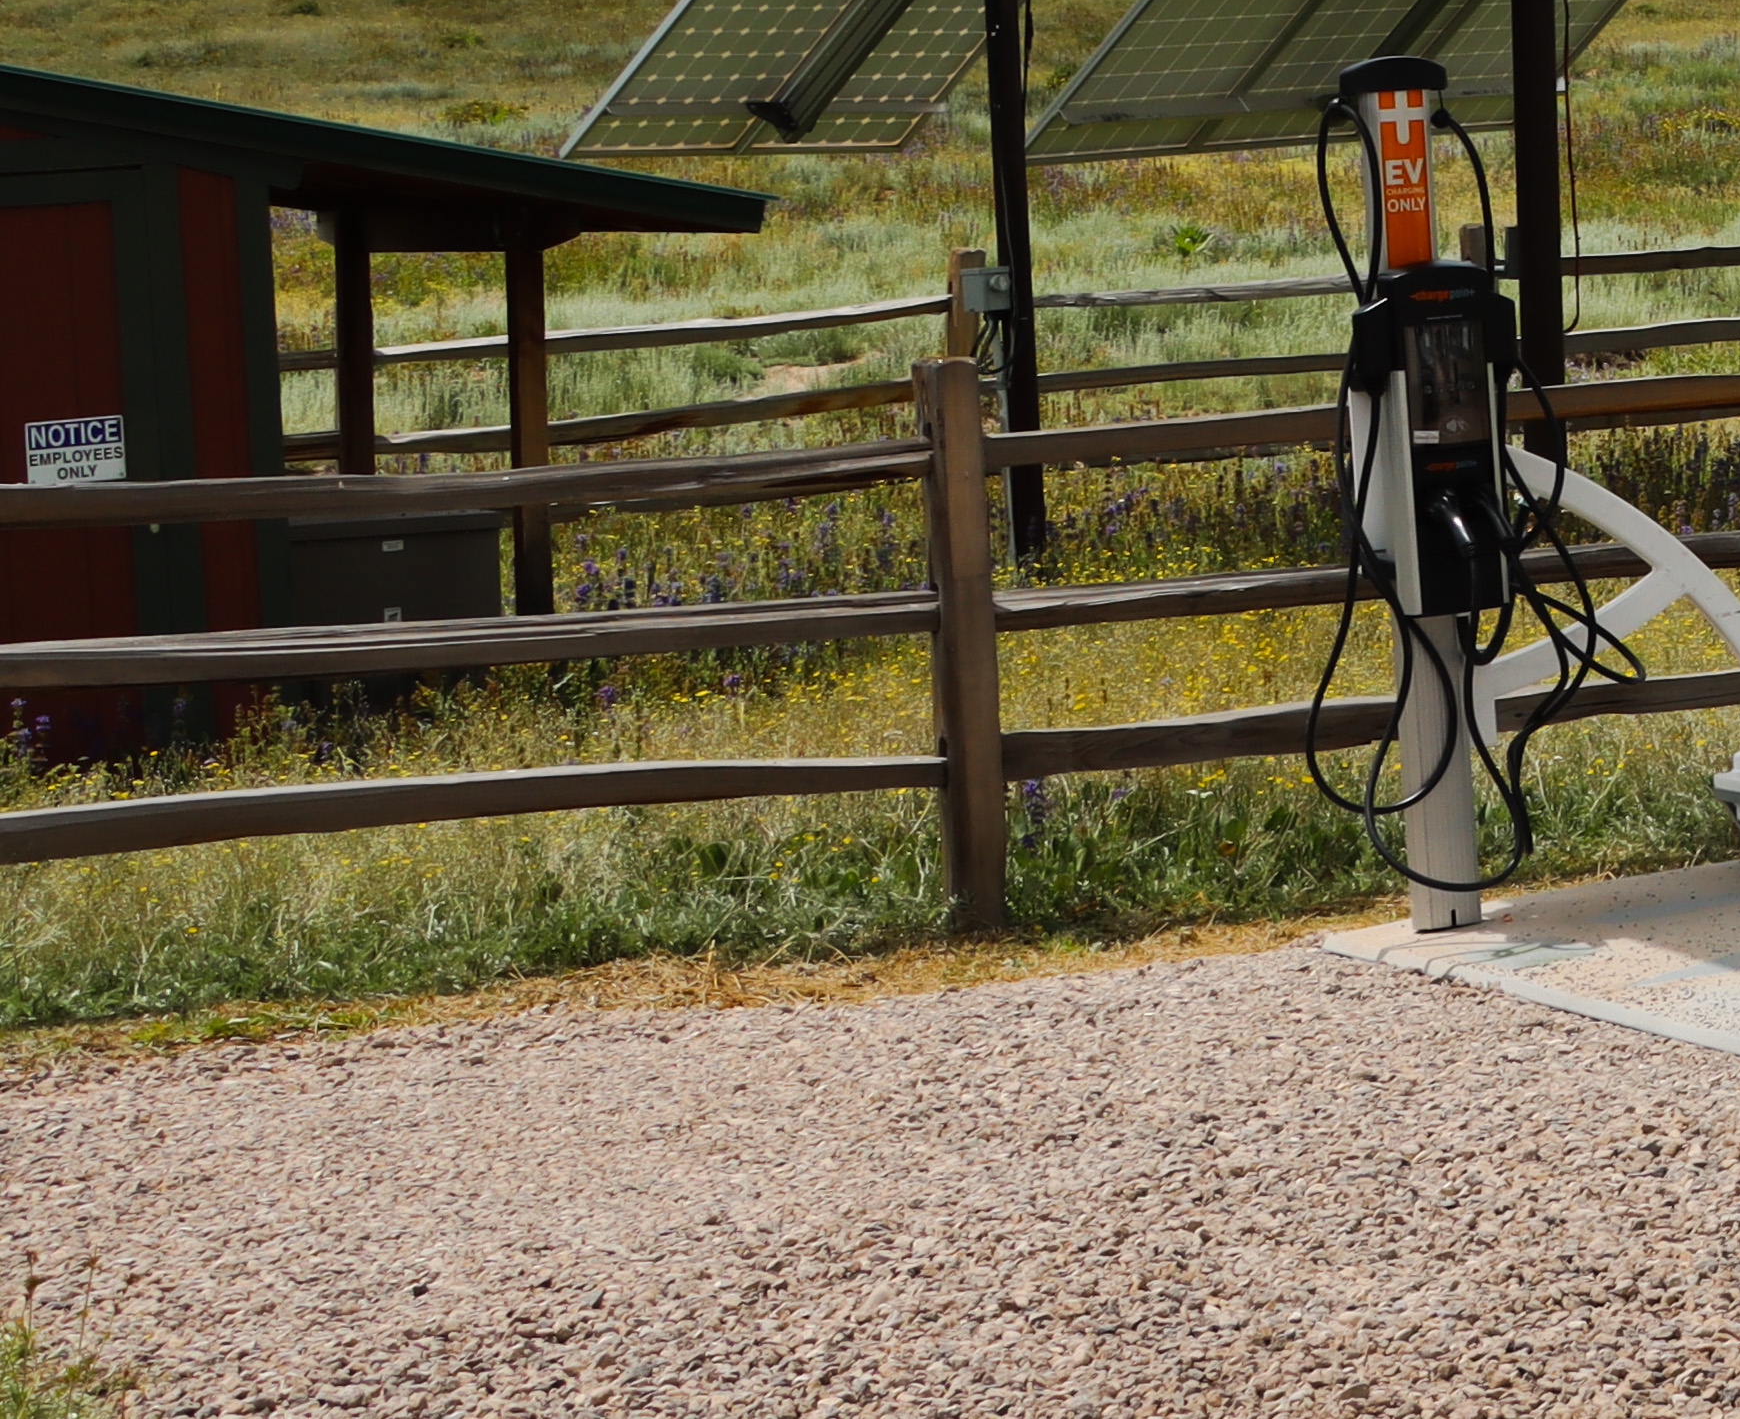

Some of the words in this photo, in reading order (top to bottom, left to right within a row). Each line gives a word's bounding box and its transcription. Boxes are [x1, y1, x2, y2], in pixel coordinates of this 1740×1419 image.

[1385, 158, 1424, 185] EV
[1387, 197, 1426, 212] ONLY
[30, 420, 119, 449] NOTICE
[29, 446, 124, 467] EMPLOYEES
[57, 464, 97, 480] ONLY
